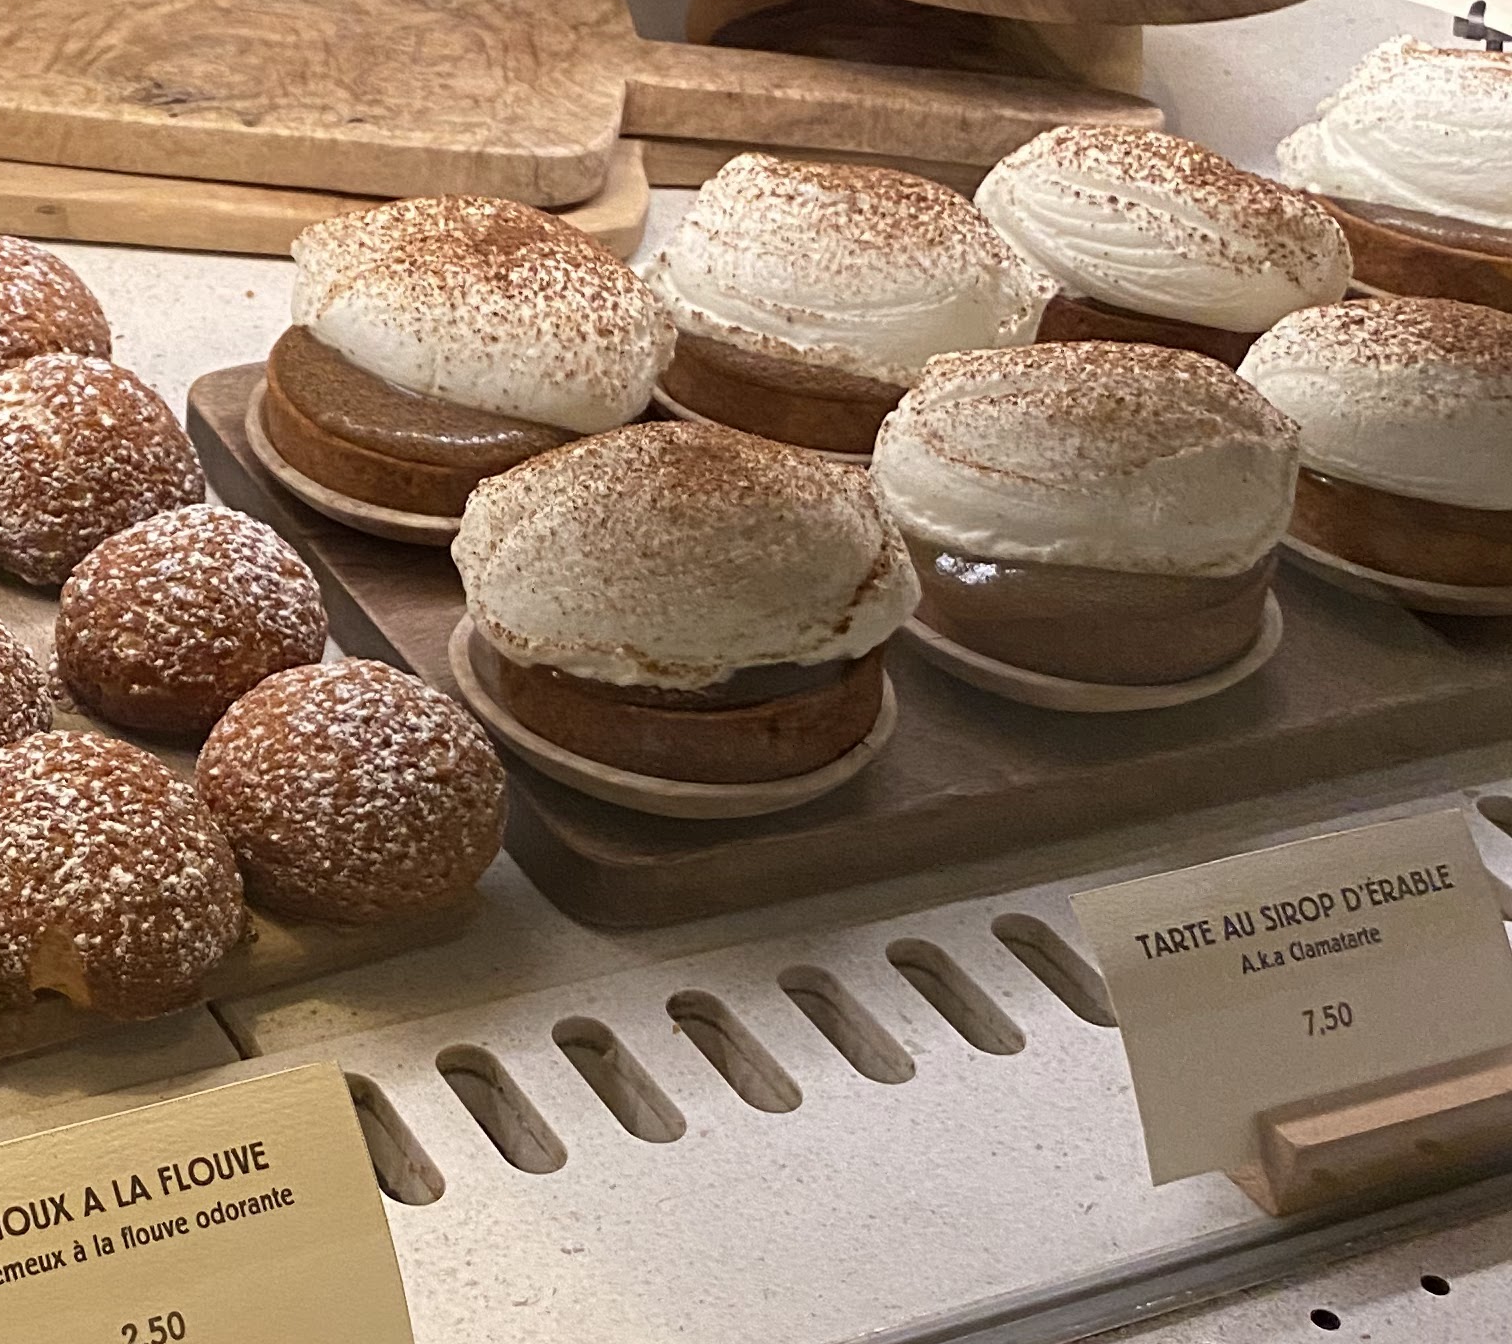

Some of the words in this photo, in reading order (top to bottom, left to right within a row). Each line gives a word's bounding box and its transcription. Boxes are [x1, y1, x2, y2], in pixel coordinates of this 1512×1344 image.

[1135, 920, 1216, 959] TARTE
[1224, 911, 1255, 941] AU
[1260, 893, 1335, 931] SIROP
[1289, 928, 1382, 961] Clamatarte
[1302, 1002, 1352, 1036] 7,50
[84, 1187, 106, 1217] A
[112, 1175, 152, 1207] LA
[157, 1141, 269, 1195] FLOUVE
[74, 1240, 87, 1262] à
[93, 1234, 115, 1257] la
[121, 1217, 189, 1249] flouve
[196, 1188, 295, 1228] odorante
